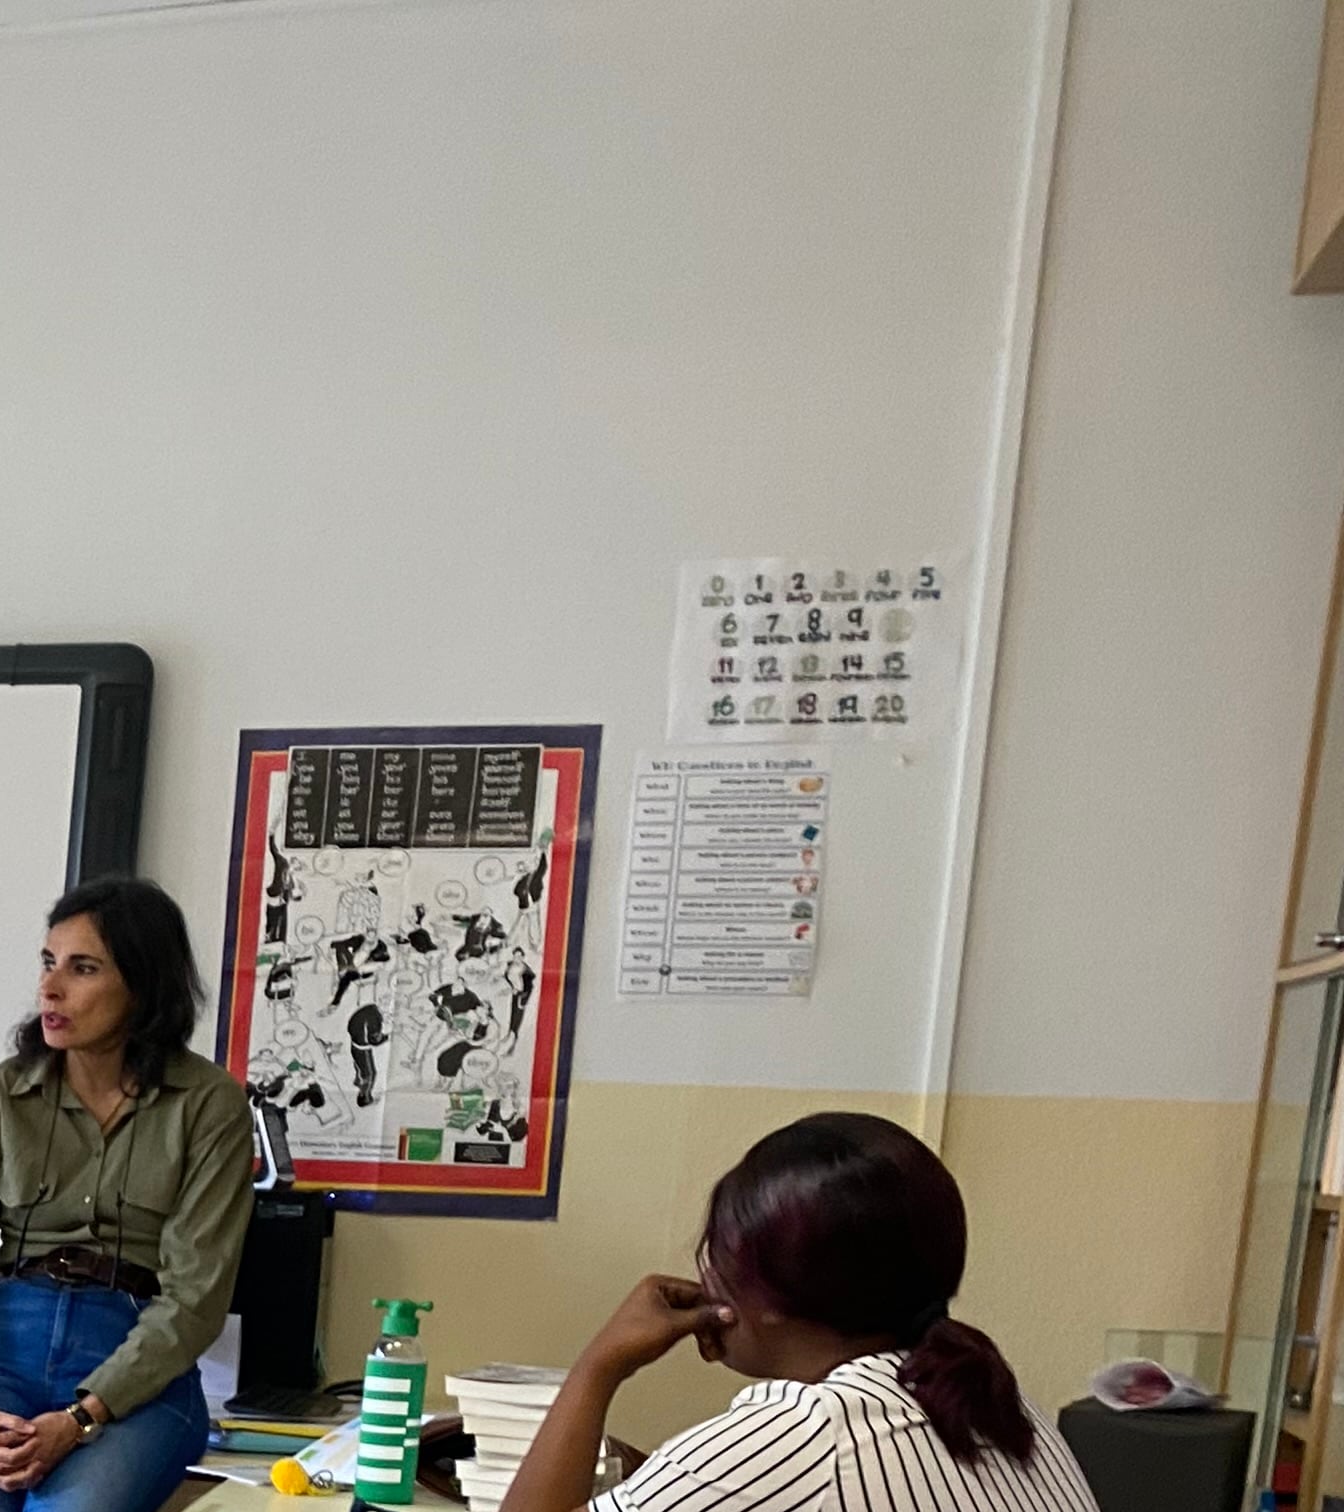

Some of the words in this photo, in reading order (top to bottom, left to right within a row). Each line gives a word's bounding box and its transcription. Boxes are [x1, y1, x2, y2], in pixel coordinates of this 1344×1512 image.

[712, 575, 724, 593] 0
[755, 574, 764, 590] 1
[792, 573, 805, 590] 2
[876, 570, 890, 586] 4
[920, 567, 934, 587] 5
[720, 612, 738, 634] 6
[765, 614, 780, 632] 7
[808, 609, 822, 631] 8
[847, 608, 863, 627] 9
[718, 657, 734, 674] 11
[758, 656, 778, 674] 12
[800, 655, 819, 673] 13
[842, 654, 862, 671] 14
[884, 652, 904, 672] 15
[712, 695, 735, 716] 16
[754, 696, 776, 714] 17
[797, 693, 818, 715] 18
[838, 695, 858, 714] 19
[874, 694, 904, 713] 20
